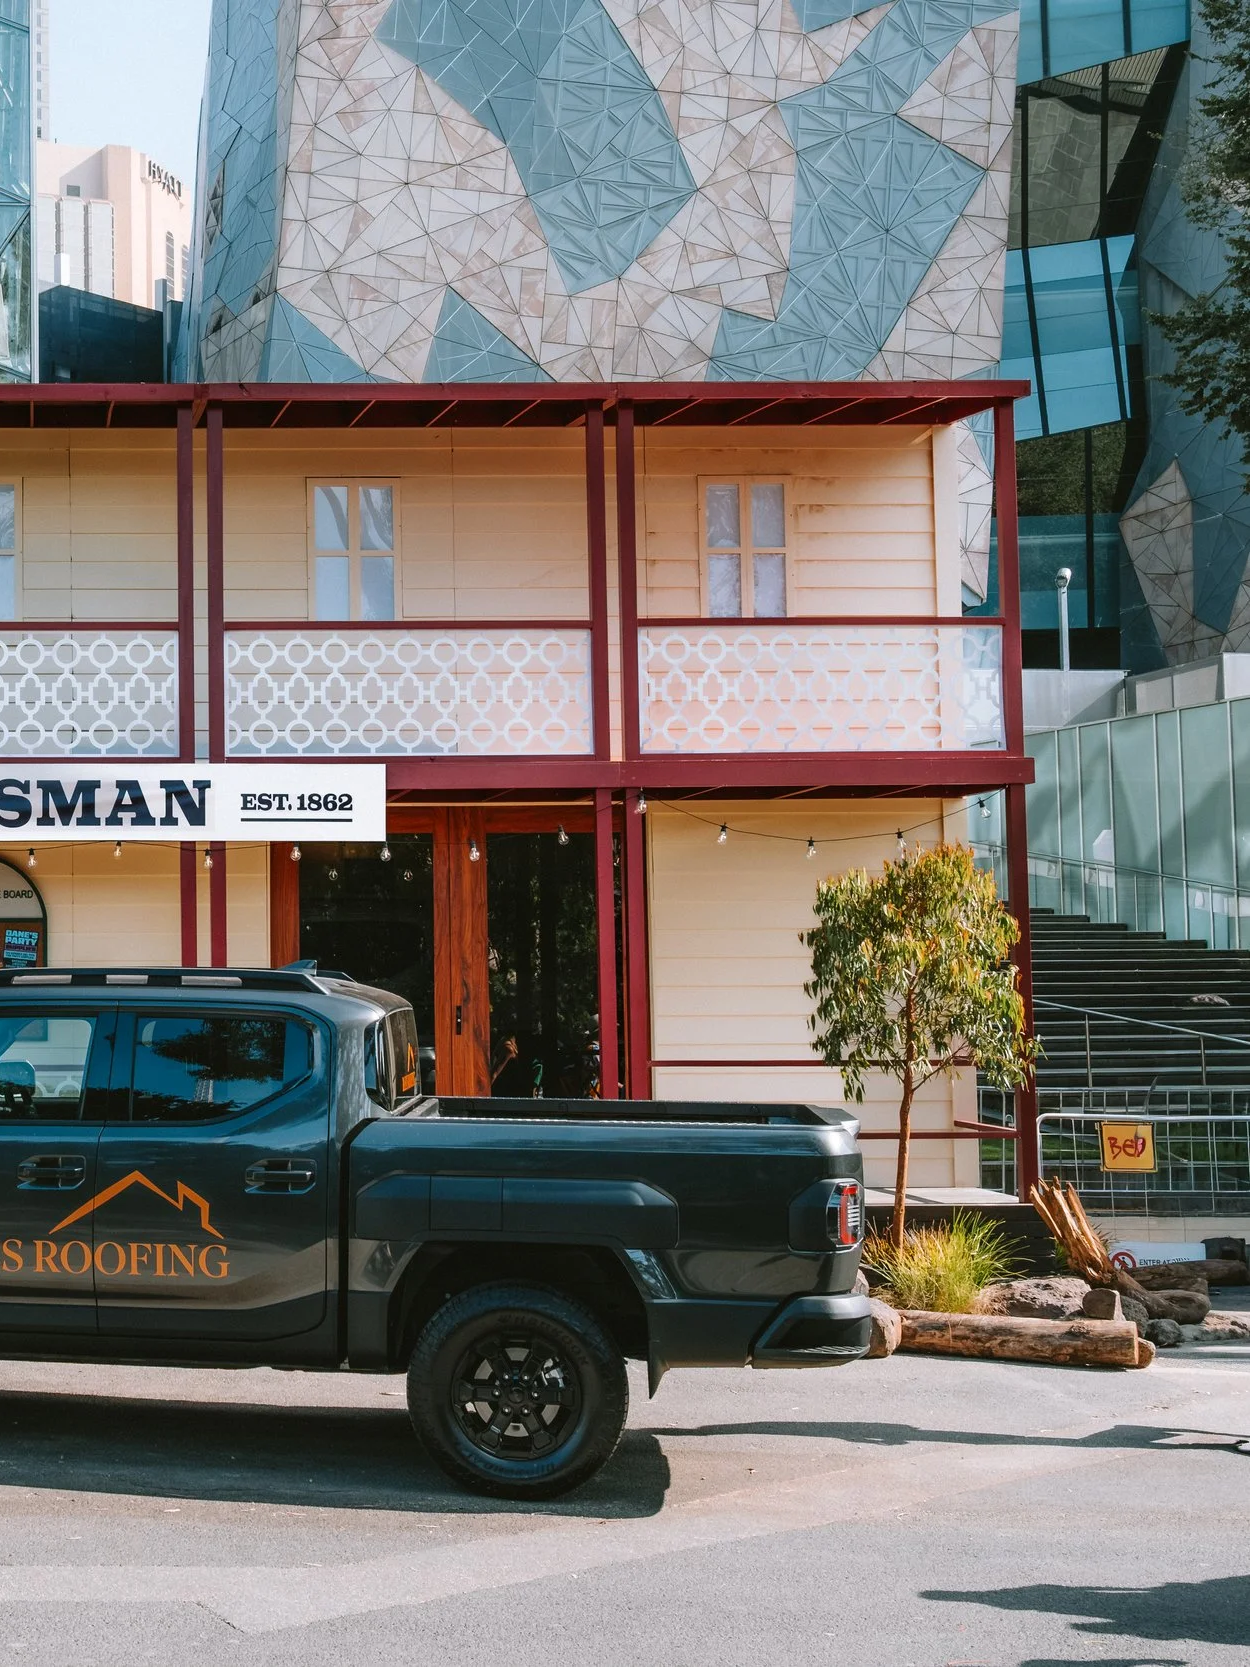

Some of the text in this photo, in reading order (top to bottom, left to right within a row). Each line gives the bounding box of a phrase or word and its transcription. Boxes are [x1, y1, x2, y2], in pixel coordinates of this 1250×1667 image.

[240, 794, 292, 812] EST.
[296, 793, 354, 812] 1862
[3, 890, 34, 899] BOARD
[5, 936, 38, 945] PARTY
[34, 1239, 231, 1279] ROOFING
[1139, 1258, 1161, 1266] ENTER
